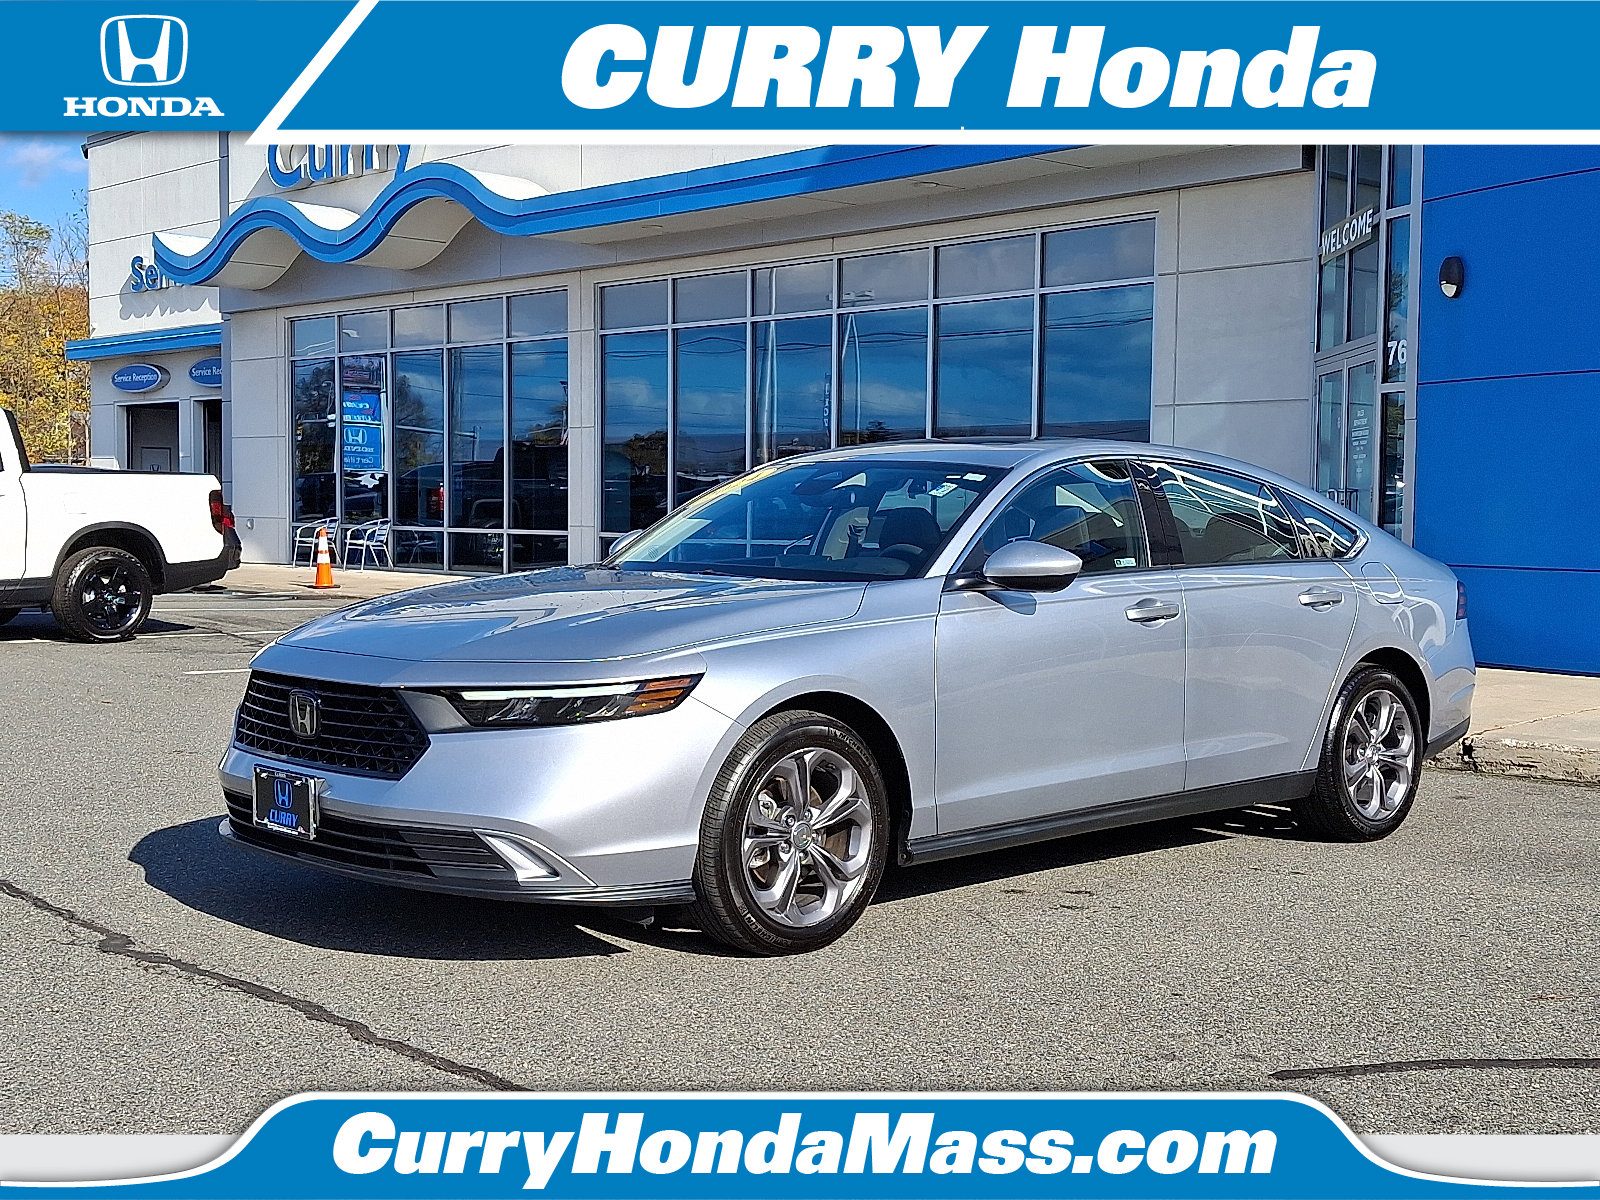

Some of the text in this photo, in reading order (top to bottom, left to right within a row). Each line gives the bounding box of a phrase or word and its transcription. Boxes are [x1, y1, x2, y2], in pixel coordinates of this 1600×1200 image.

[1321, 208, 1373, 256] WELCOME
[1387, 340, 1407, 365] 76
[114, 372, 157, 383] Service Reception
[191, 367, 212, 377] Service
[270, 809, 298, 827] CURRY
